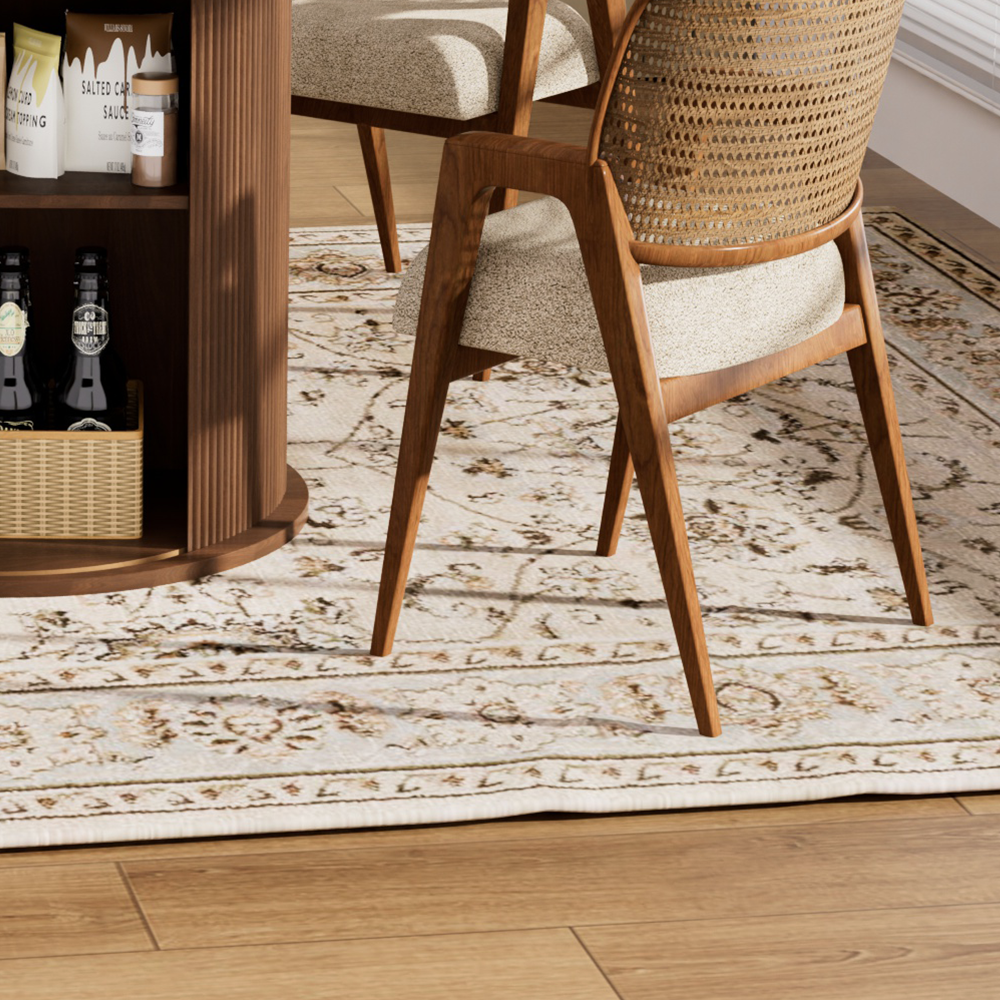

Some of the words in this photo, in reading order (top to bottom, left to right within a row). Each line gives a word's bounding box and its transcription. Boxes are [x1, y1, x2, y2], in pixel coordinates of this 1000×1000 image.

[81, 80, 112, 96] SALTED
[16, 111, 47, 128] TOPPING
[103, 105, 129, 120] SAUCE
